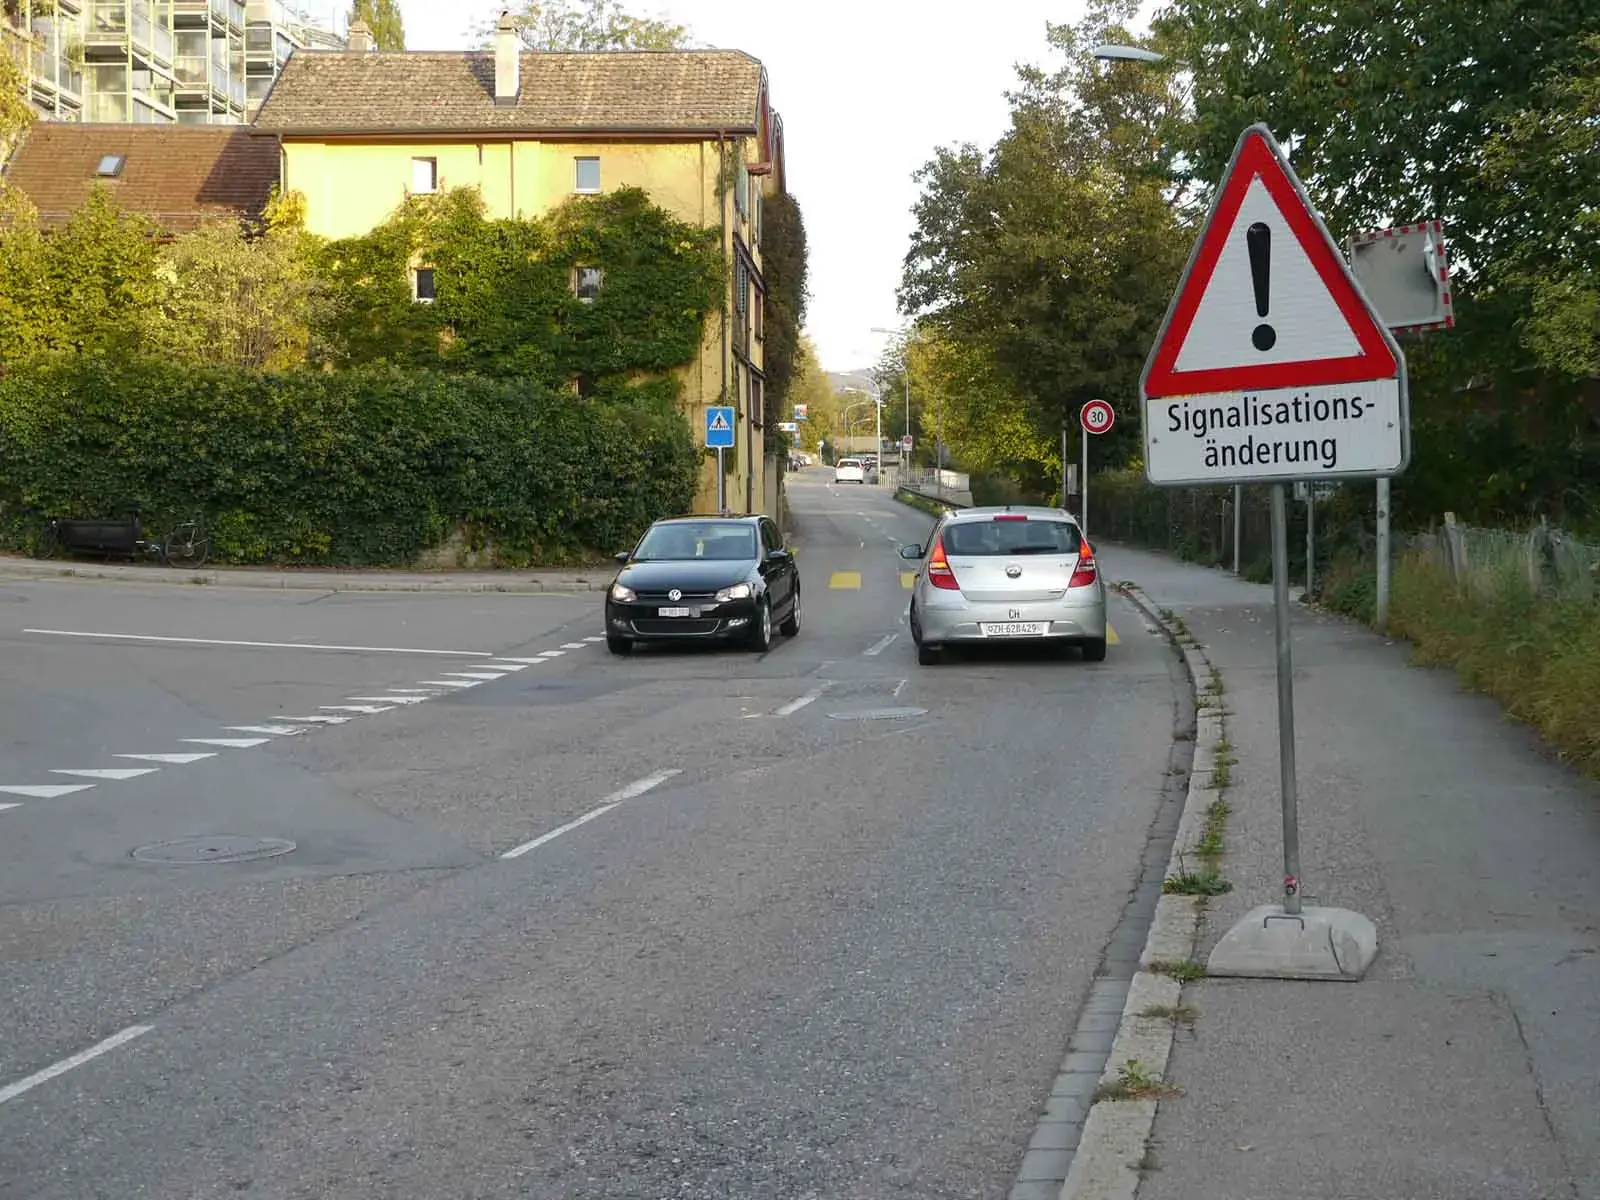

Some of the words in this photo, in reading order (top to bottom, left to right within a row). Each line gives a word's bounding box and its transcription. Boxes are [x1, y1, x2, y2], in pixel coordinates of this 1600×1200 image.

[1091, 411, 1104, 423] 30
[1168, 392, 1376, 438] Signalisations-
[1204, 435, 1338, 468] änderung
[1008, 608, 1020, 619] CH
